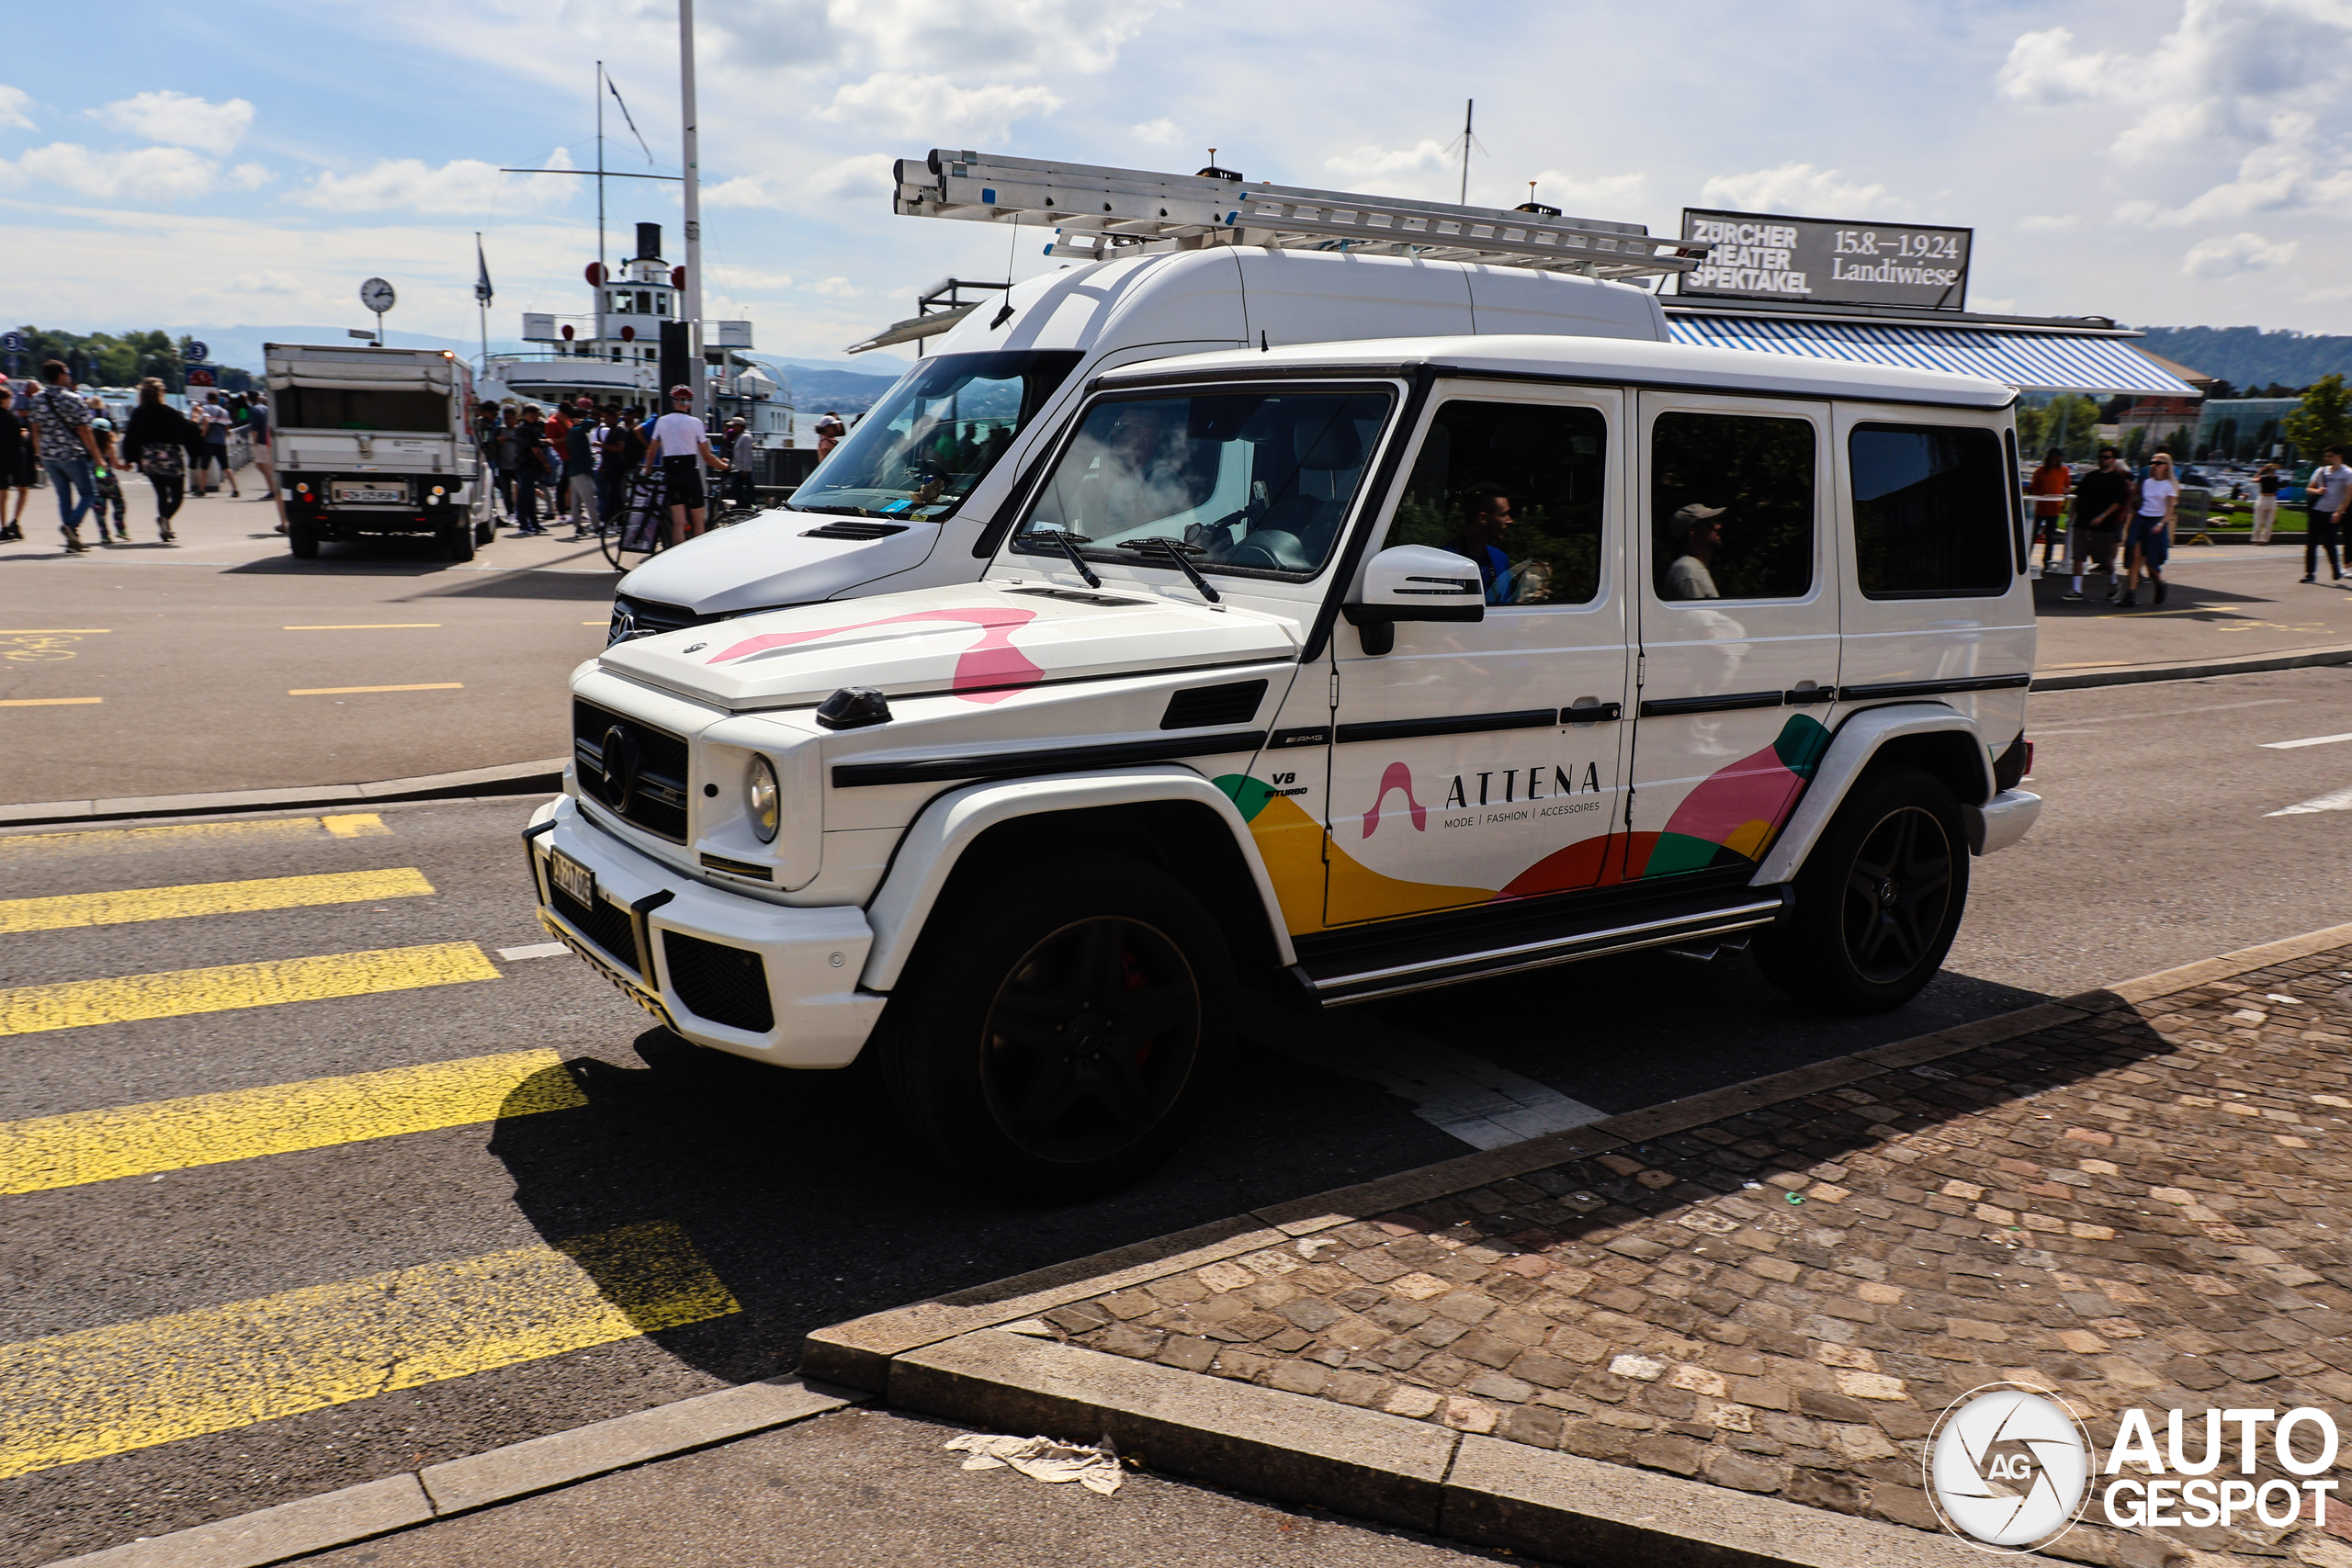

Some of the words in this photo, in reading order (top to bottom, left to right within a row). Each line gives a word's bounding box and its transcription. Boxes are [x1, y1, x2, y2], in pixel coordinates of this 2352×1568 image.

[1699, 244, 1791, 270] HEATER
[1688, 264, 1812, 293] SPEKTAKEL
[1831, 257, 1958, 286] Landiwiese
[6, 336, 17, 347] 3
[195, 345, 203, 356] 3
[1272, 773, 1295, 784] V8
[1446, 761, 1600, 809] ATTENA
[1264, 787, 1307, 797] BITURBO
[1444, 817, 1474, 829] MODE
[1487, 810, 1528, 824] FASHION
[1540, 802, 1600, 817] ACCESSOIRES
